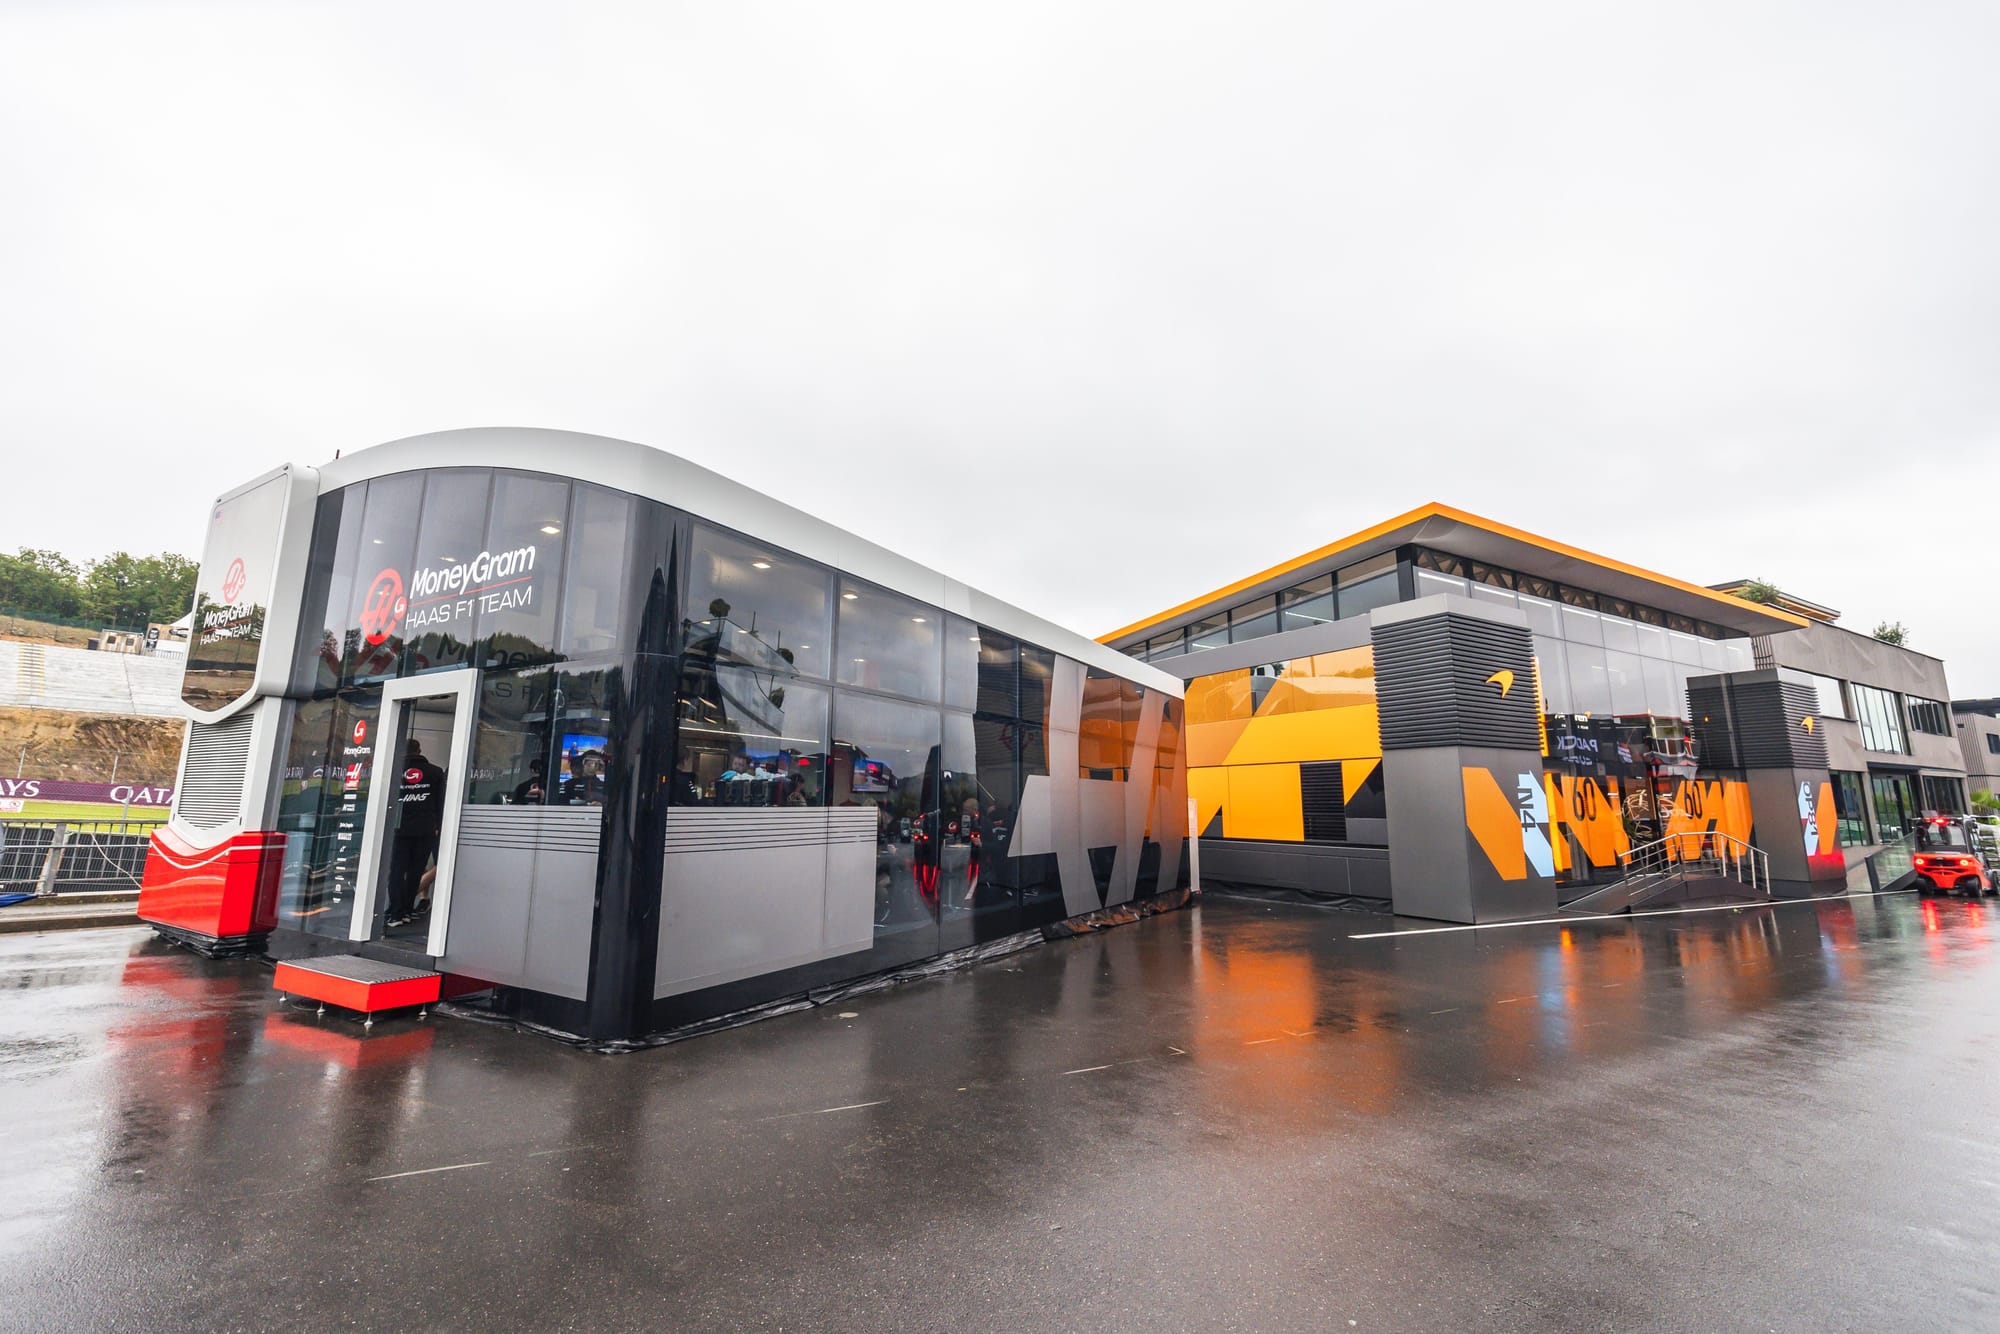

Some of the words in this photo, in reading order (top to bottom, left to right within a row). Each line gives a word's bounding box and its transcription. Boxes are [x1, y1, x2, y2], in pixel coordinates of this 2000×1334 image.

[410, 545, 536, 599] MoneyGram
[203, 602, 254, 629] MoneyGram
[405, 602, 451, 630] HAAS
[455, 598, 475, 620] F1
[478, 586, 533, 617] TEAM
[230, 623, 252, 638] TEAM
[1573, 776, 1597, 822] 60
[1684, 780, 1703, 820] 60
